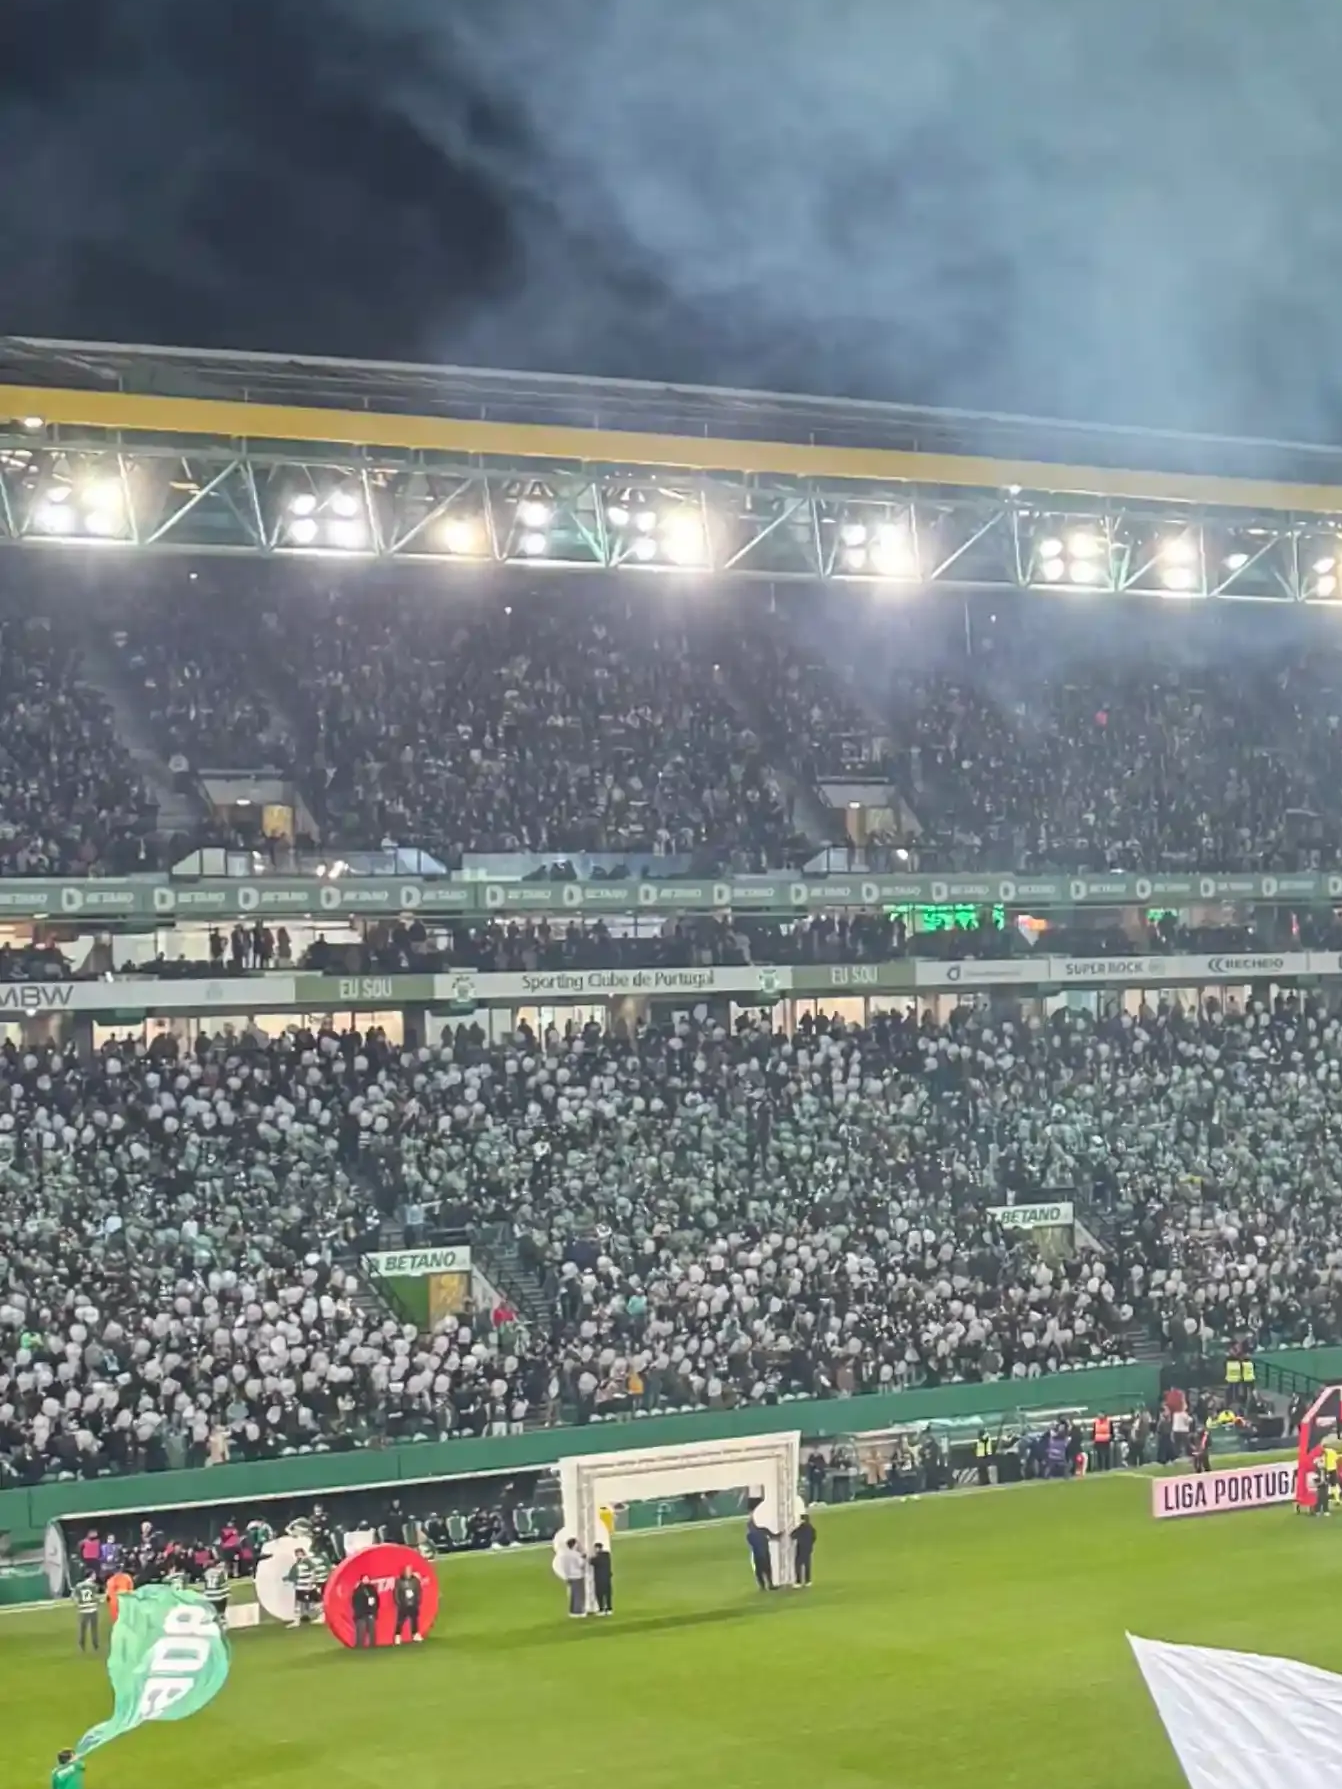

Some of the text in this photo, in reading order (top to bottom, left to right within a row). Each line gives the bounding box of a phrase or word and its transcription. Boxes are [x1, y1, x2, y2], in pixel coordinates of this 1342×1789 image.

[339, 978, 393, 999] EU SOU
[521, 969, 715, 992] Sporting Clube de Portugal
[1000, 1207, 1061, 1224] BETANO
[384, 1251, 457, 1272] BETANO
[1163, 1481, 1208, 1512] LIGA
